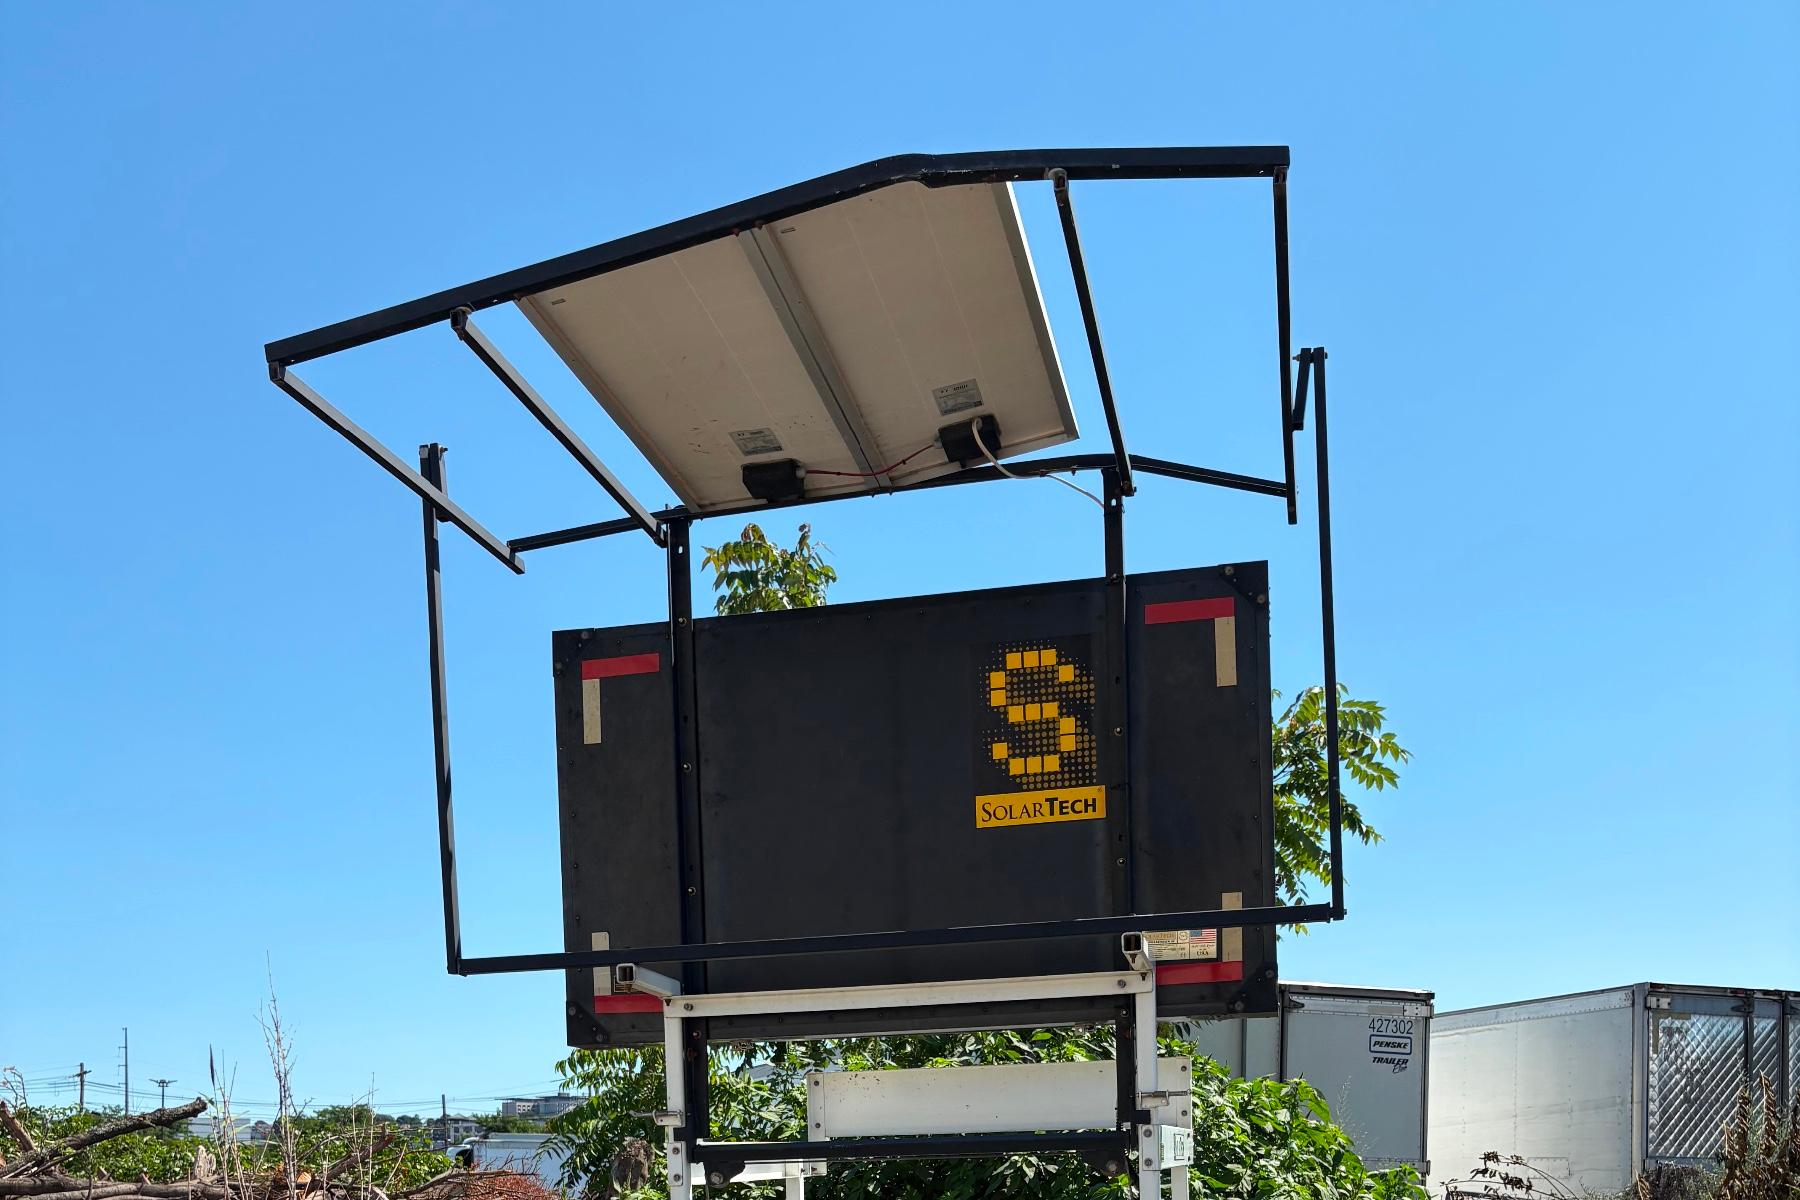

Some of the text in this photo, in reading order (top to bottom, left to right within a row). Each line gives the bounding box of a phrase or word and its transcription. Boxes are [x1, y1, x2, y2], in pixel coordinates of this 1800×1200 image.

[981, 796, 1097, 823] SOLARTECH
[1368, 1017, 1414, 1035] 427302
[1372, 1040, 1410, 1050] PENSKE
[1372, 1056, 1409, 1066] TRAILER
